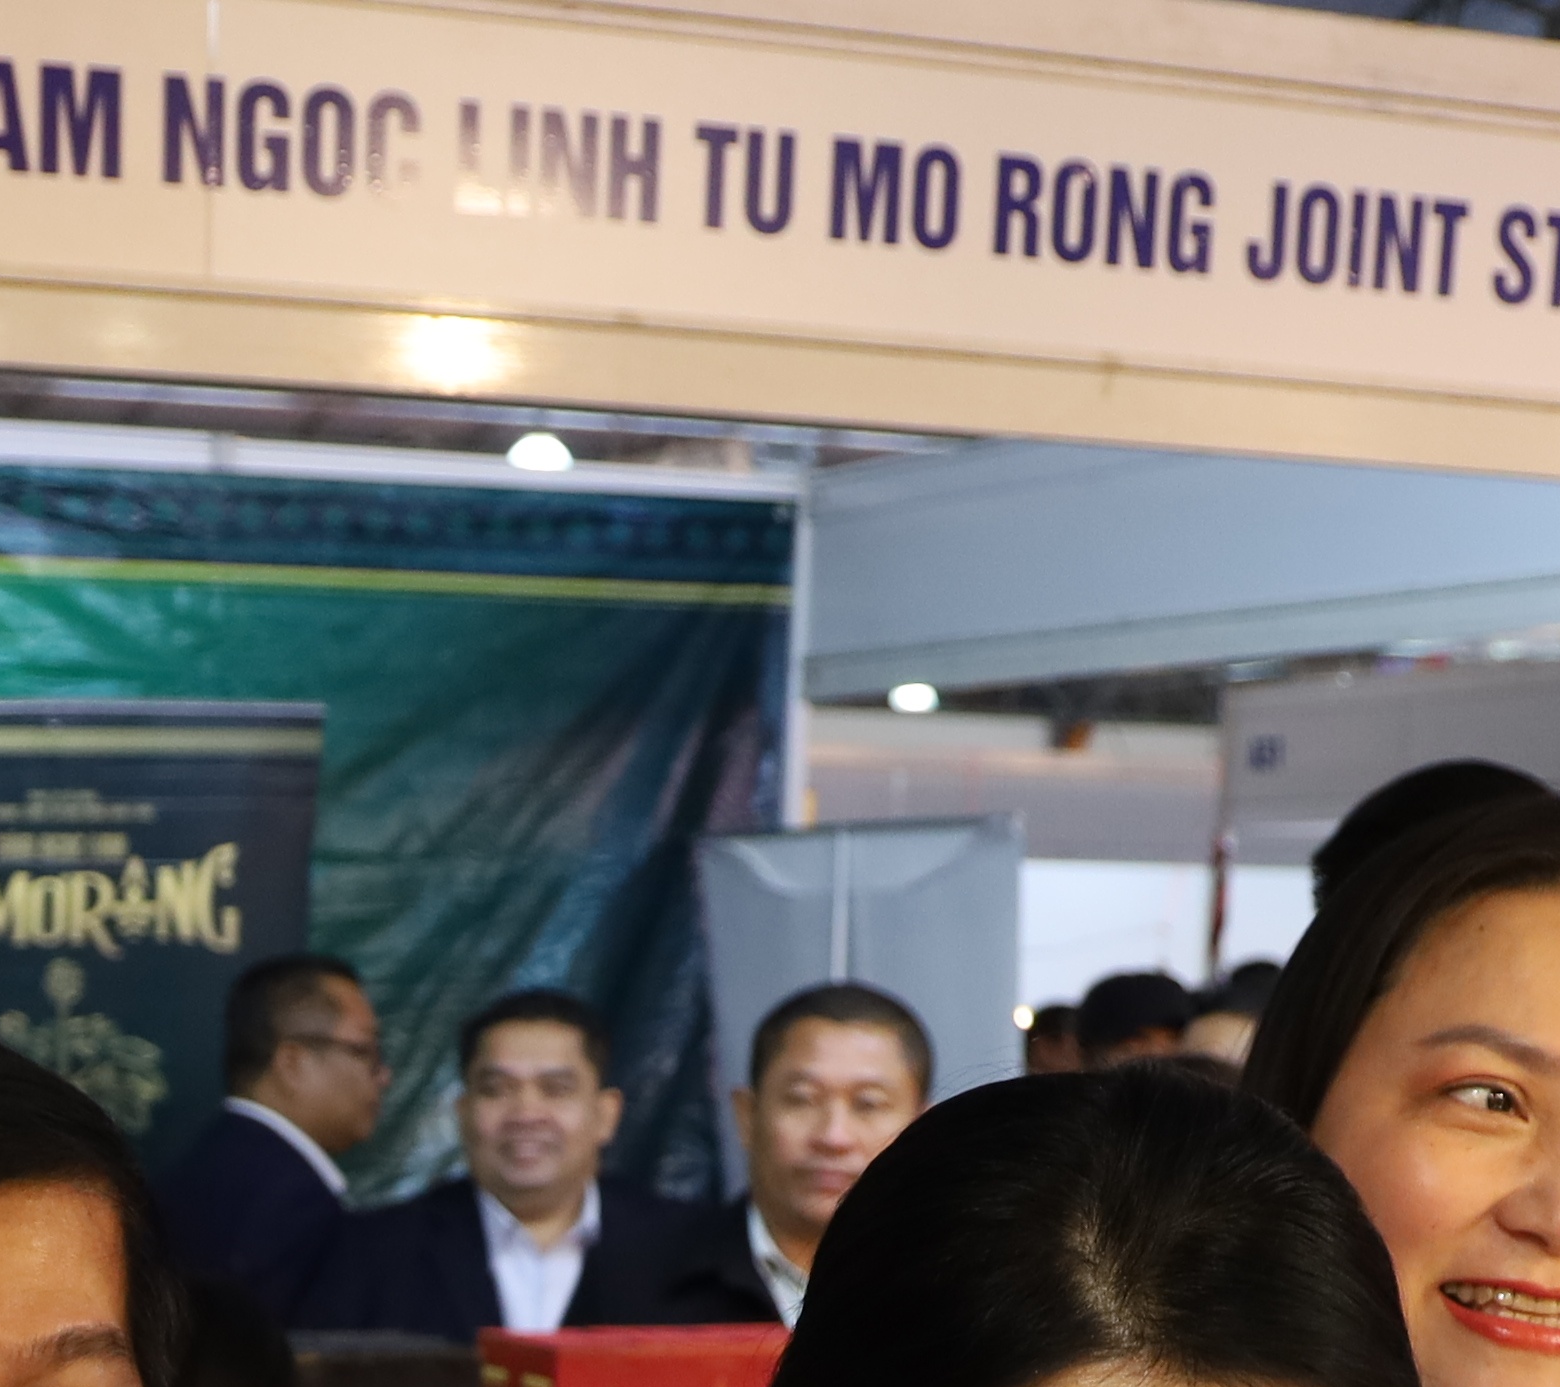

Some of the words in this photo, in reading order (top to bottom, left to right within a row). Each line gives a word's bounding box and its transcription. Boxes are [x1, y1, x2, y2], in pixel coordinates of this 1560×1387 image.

[161, 74, 424, 198] NGOC
[456, 100, 662, 226] LINH
[695, 121, 796, 238] TU
[830, 134, 961, 250] MO
[993, 155, 1213, 277] RONG
[1246, 180, 1470, 298] JOINT
